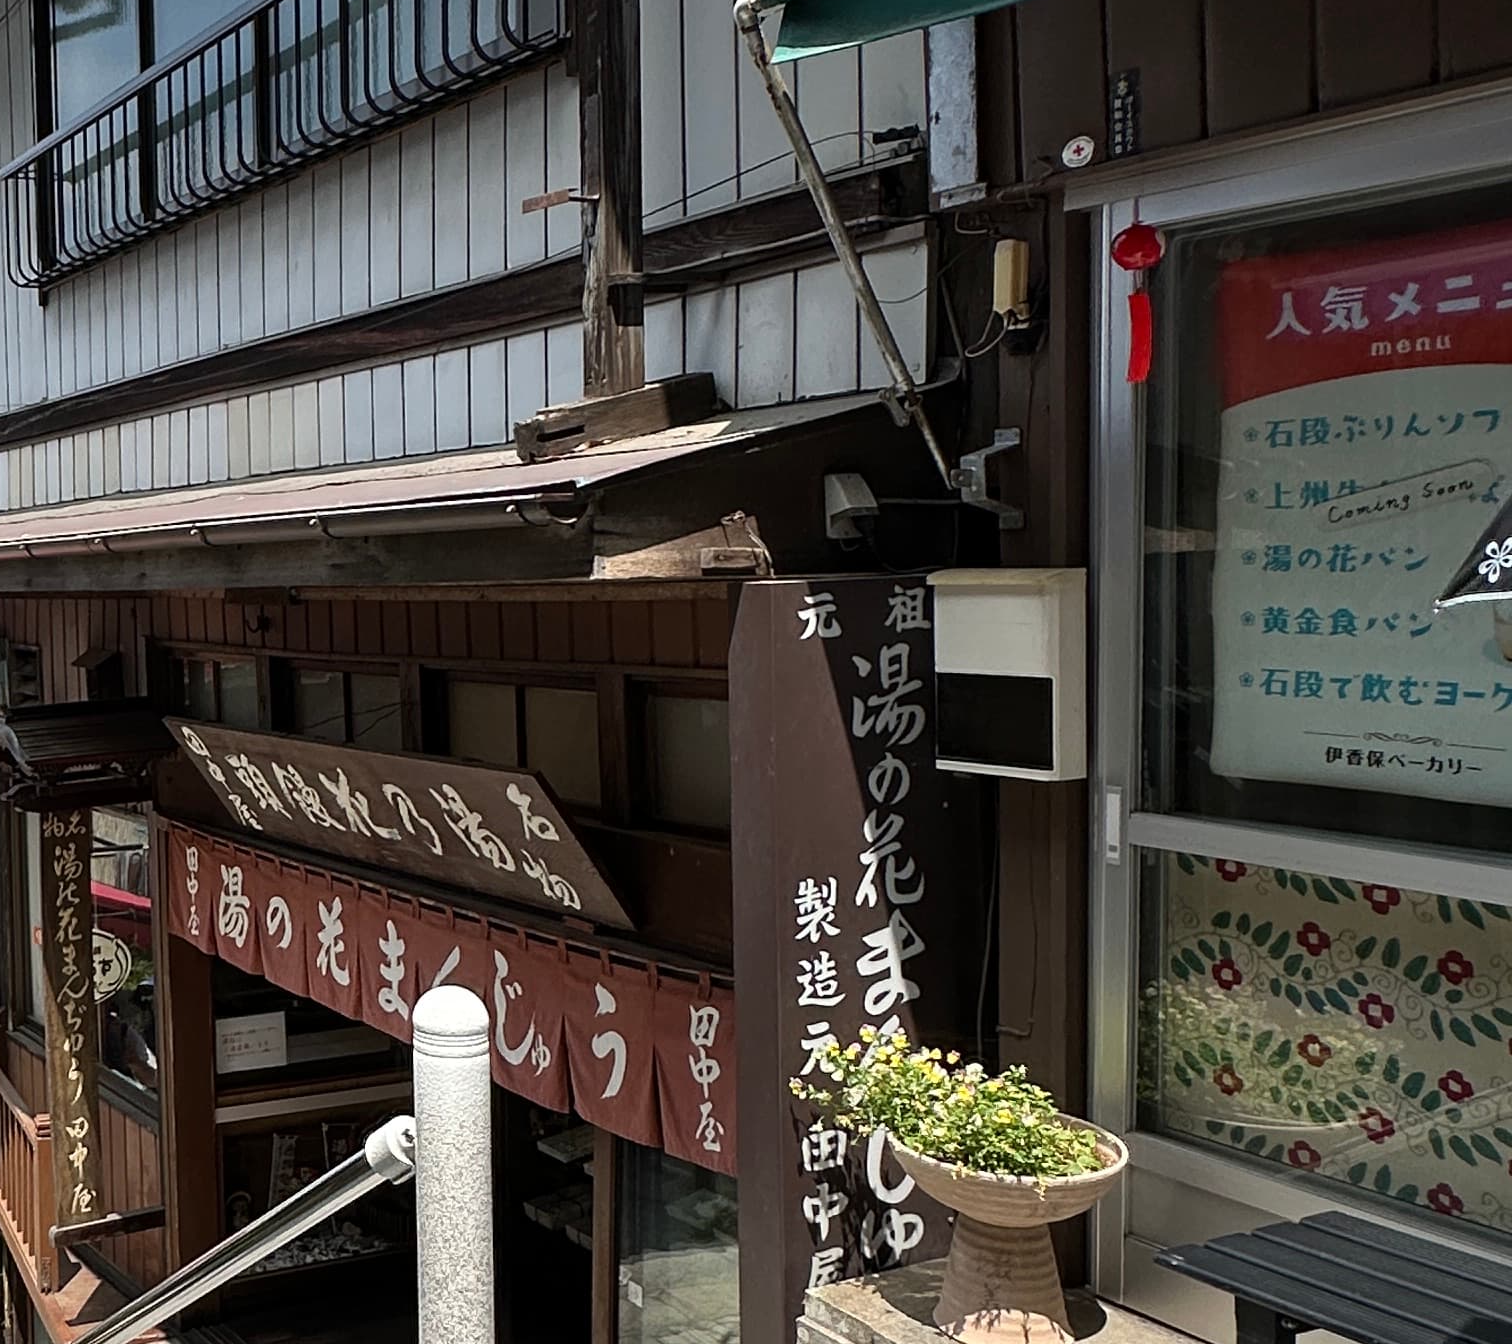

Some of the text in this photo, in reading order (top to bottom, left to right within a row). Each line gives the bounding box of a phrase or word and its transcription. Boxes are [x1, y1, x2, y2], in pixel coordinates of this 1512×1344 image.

[1369, 333, 1452, 357] menu
[1327, 492, 1411, 524] Coming
[1422, 477, 1475, 500] Soon
[1261, 542, 1432, 574] 湯の花パン
[796, 584, 933, 642] 元祖
[1260, 606, 1434, 639] 黄金食パン
[1324, 745, 1484, 776] 伊香保ベーカリー
[185, 845, 200, 937] 田中屋
[688, 1004, 726, 1153] 田中屋
[64, 1116, 97, 1216] 田中屋
